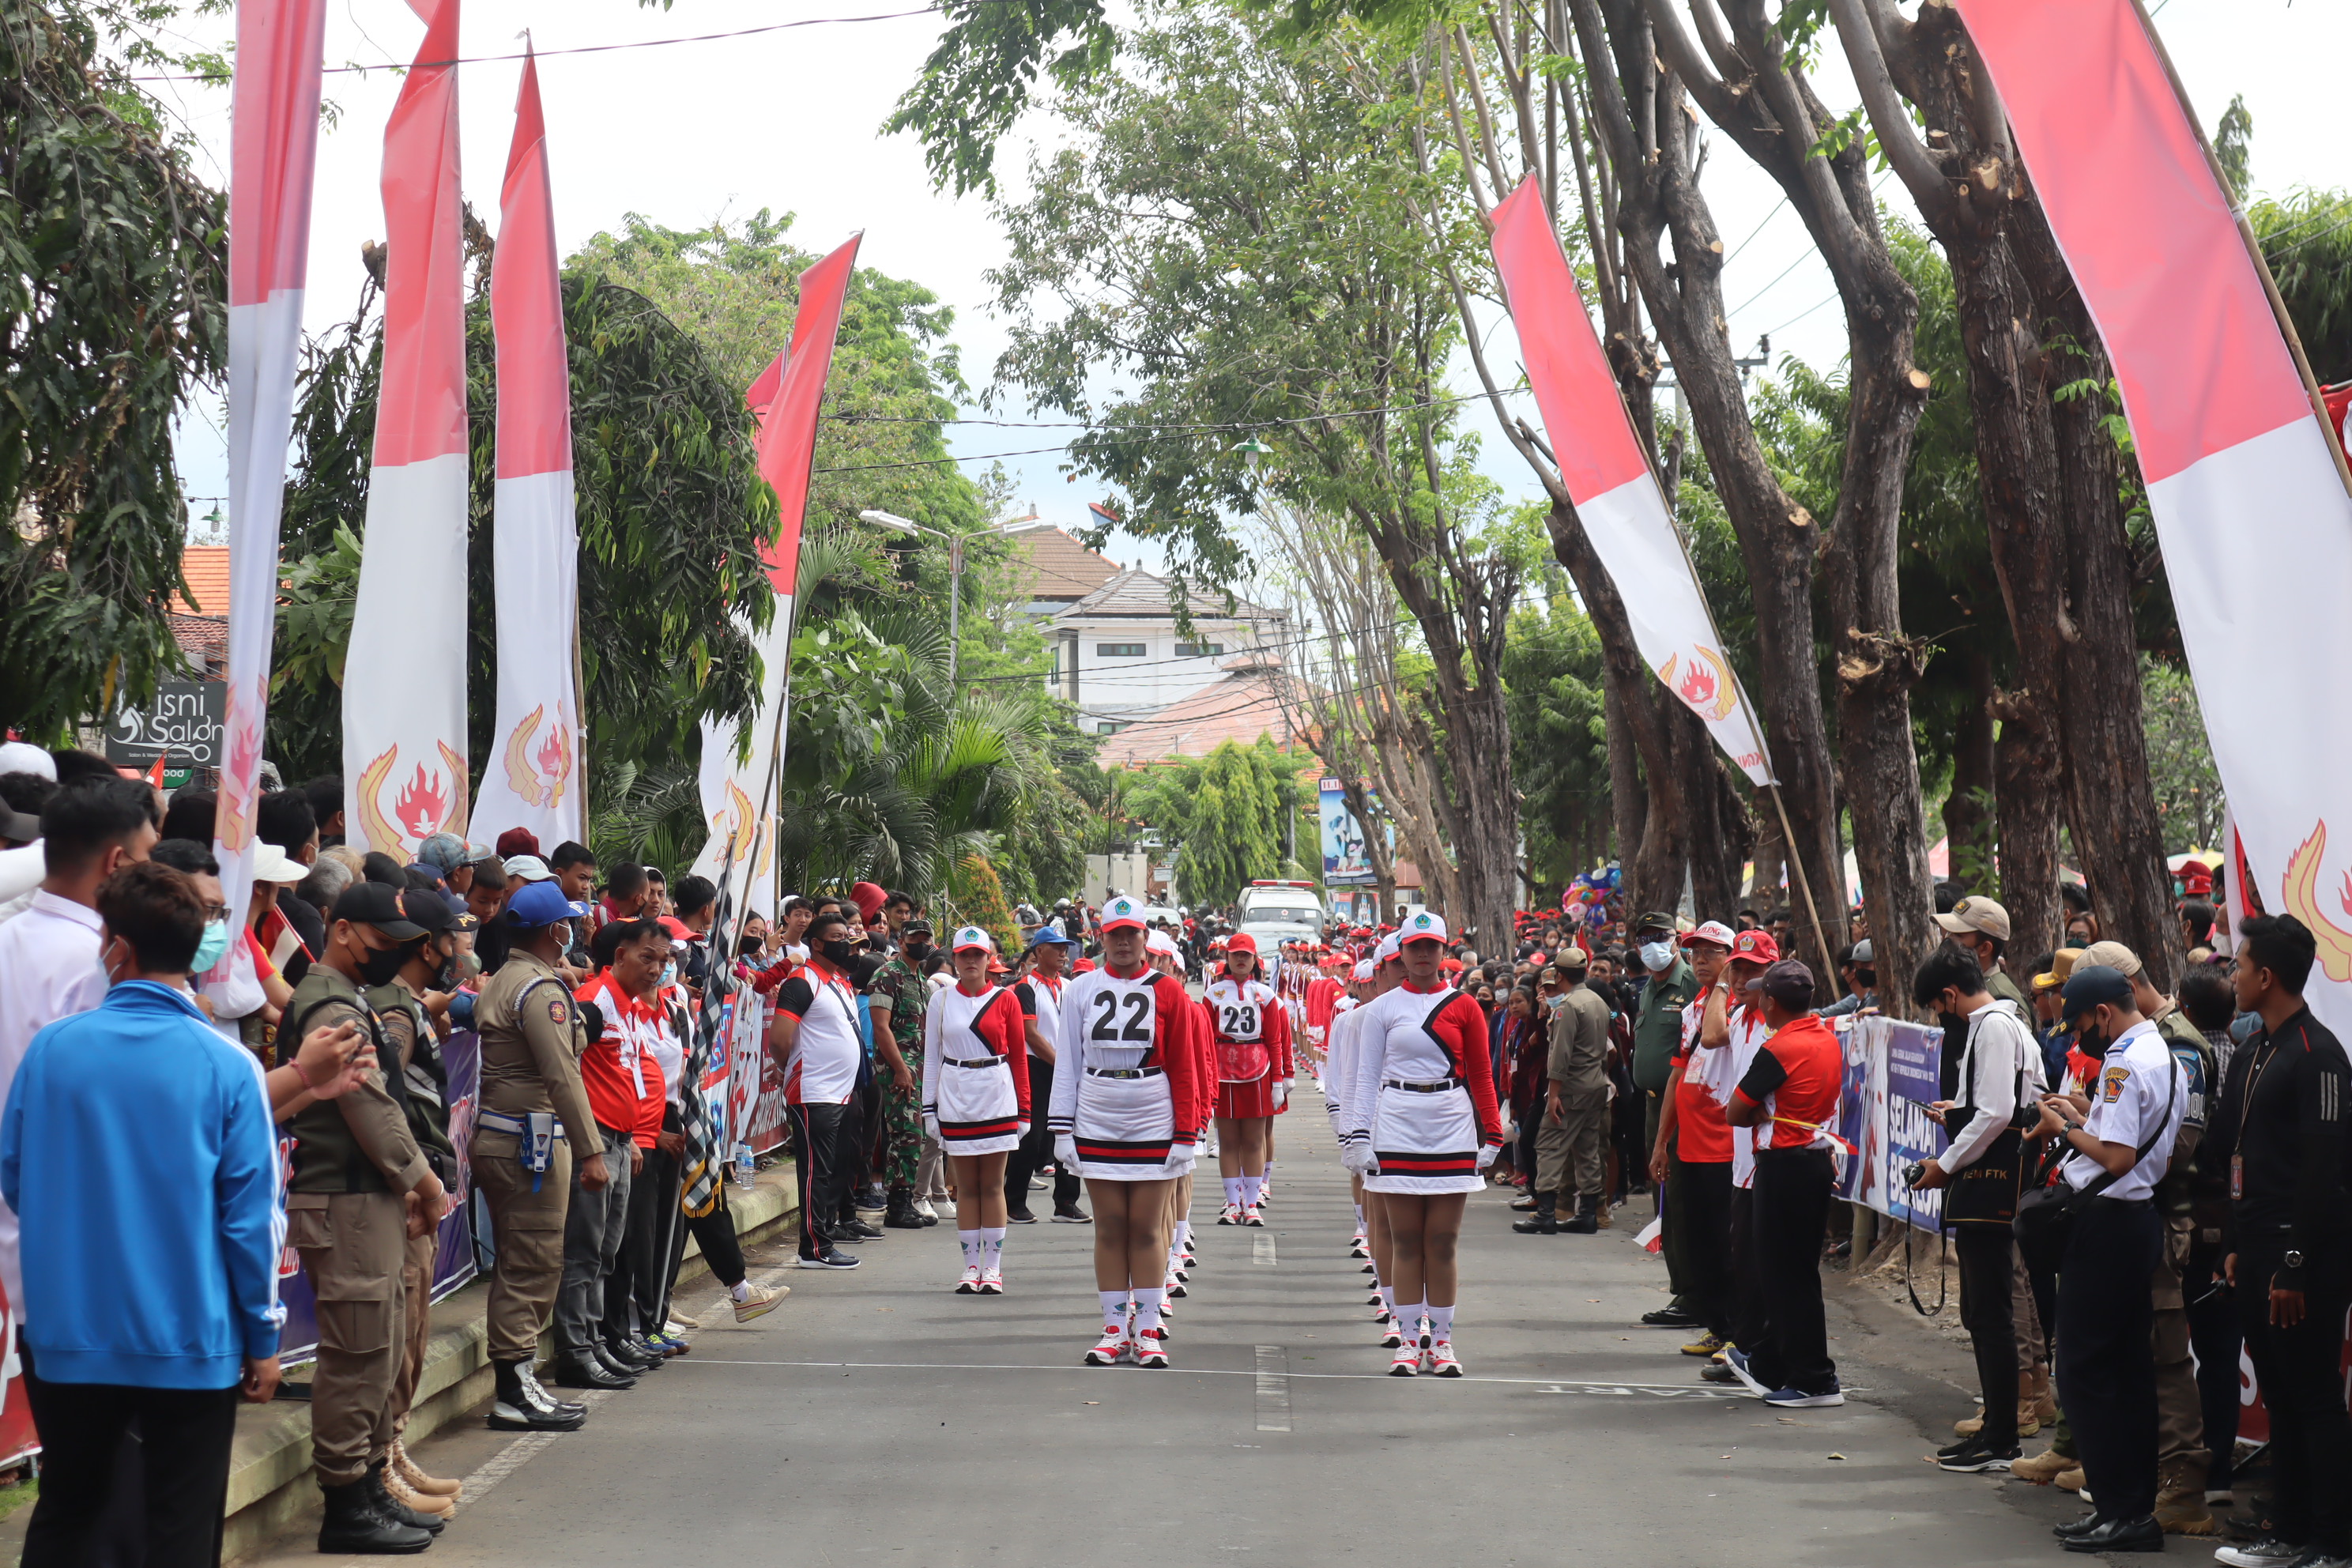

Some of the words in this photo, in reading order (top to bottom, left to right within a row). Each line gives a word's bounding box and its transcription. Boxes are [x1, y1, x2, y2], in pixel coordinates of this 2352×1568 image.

[148, 715, 224, 743] Salon
[1091, 989, 1150, 1041] 22
[1225, 1006, 1256, 1034] 23
[1985, 1170, 2007, 1180] FTK
